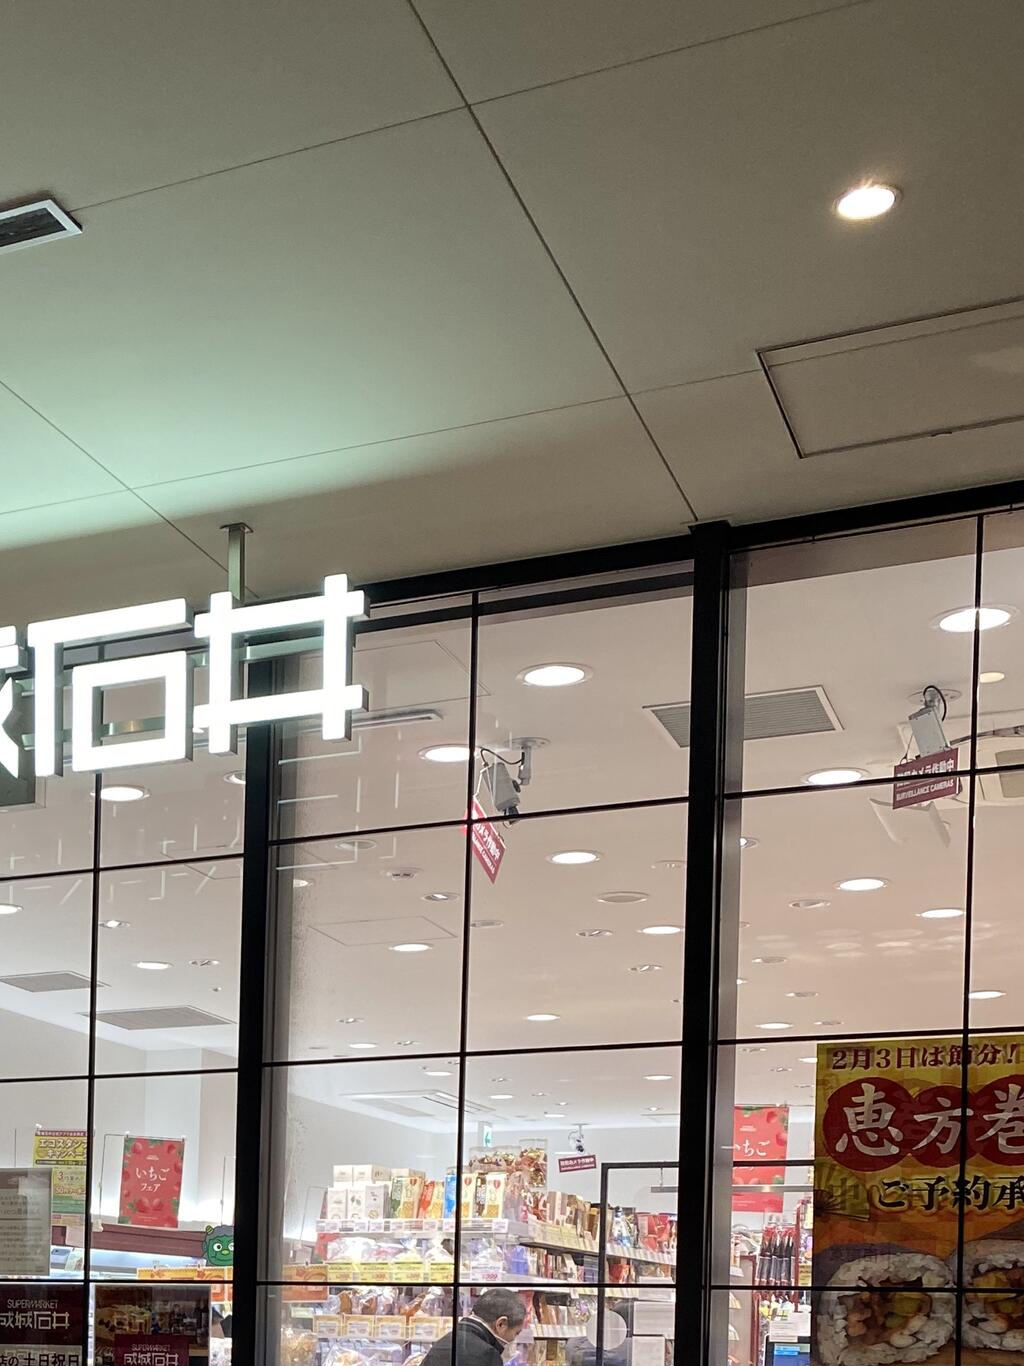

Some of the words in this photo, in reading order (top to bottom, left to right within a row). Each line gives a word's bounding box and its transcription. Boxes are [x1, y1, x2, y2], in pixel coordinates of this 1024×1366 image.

[930, 779, 954, 792] CAMERAS
[832, 1043, 1017, 1071] 2月3日は節分!
[834, 1082, 1024, 1157] 恵方巻
[135, 1166, 170, 1181] いちご
[140, 1183, 161, 1193] フェア
[7, 1299, 58, 1309] SUPERMARKET
[123, 1352, 179, 1366] 成城石井
